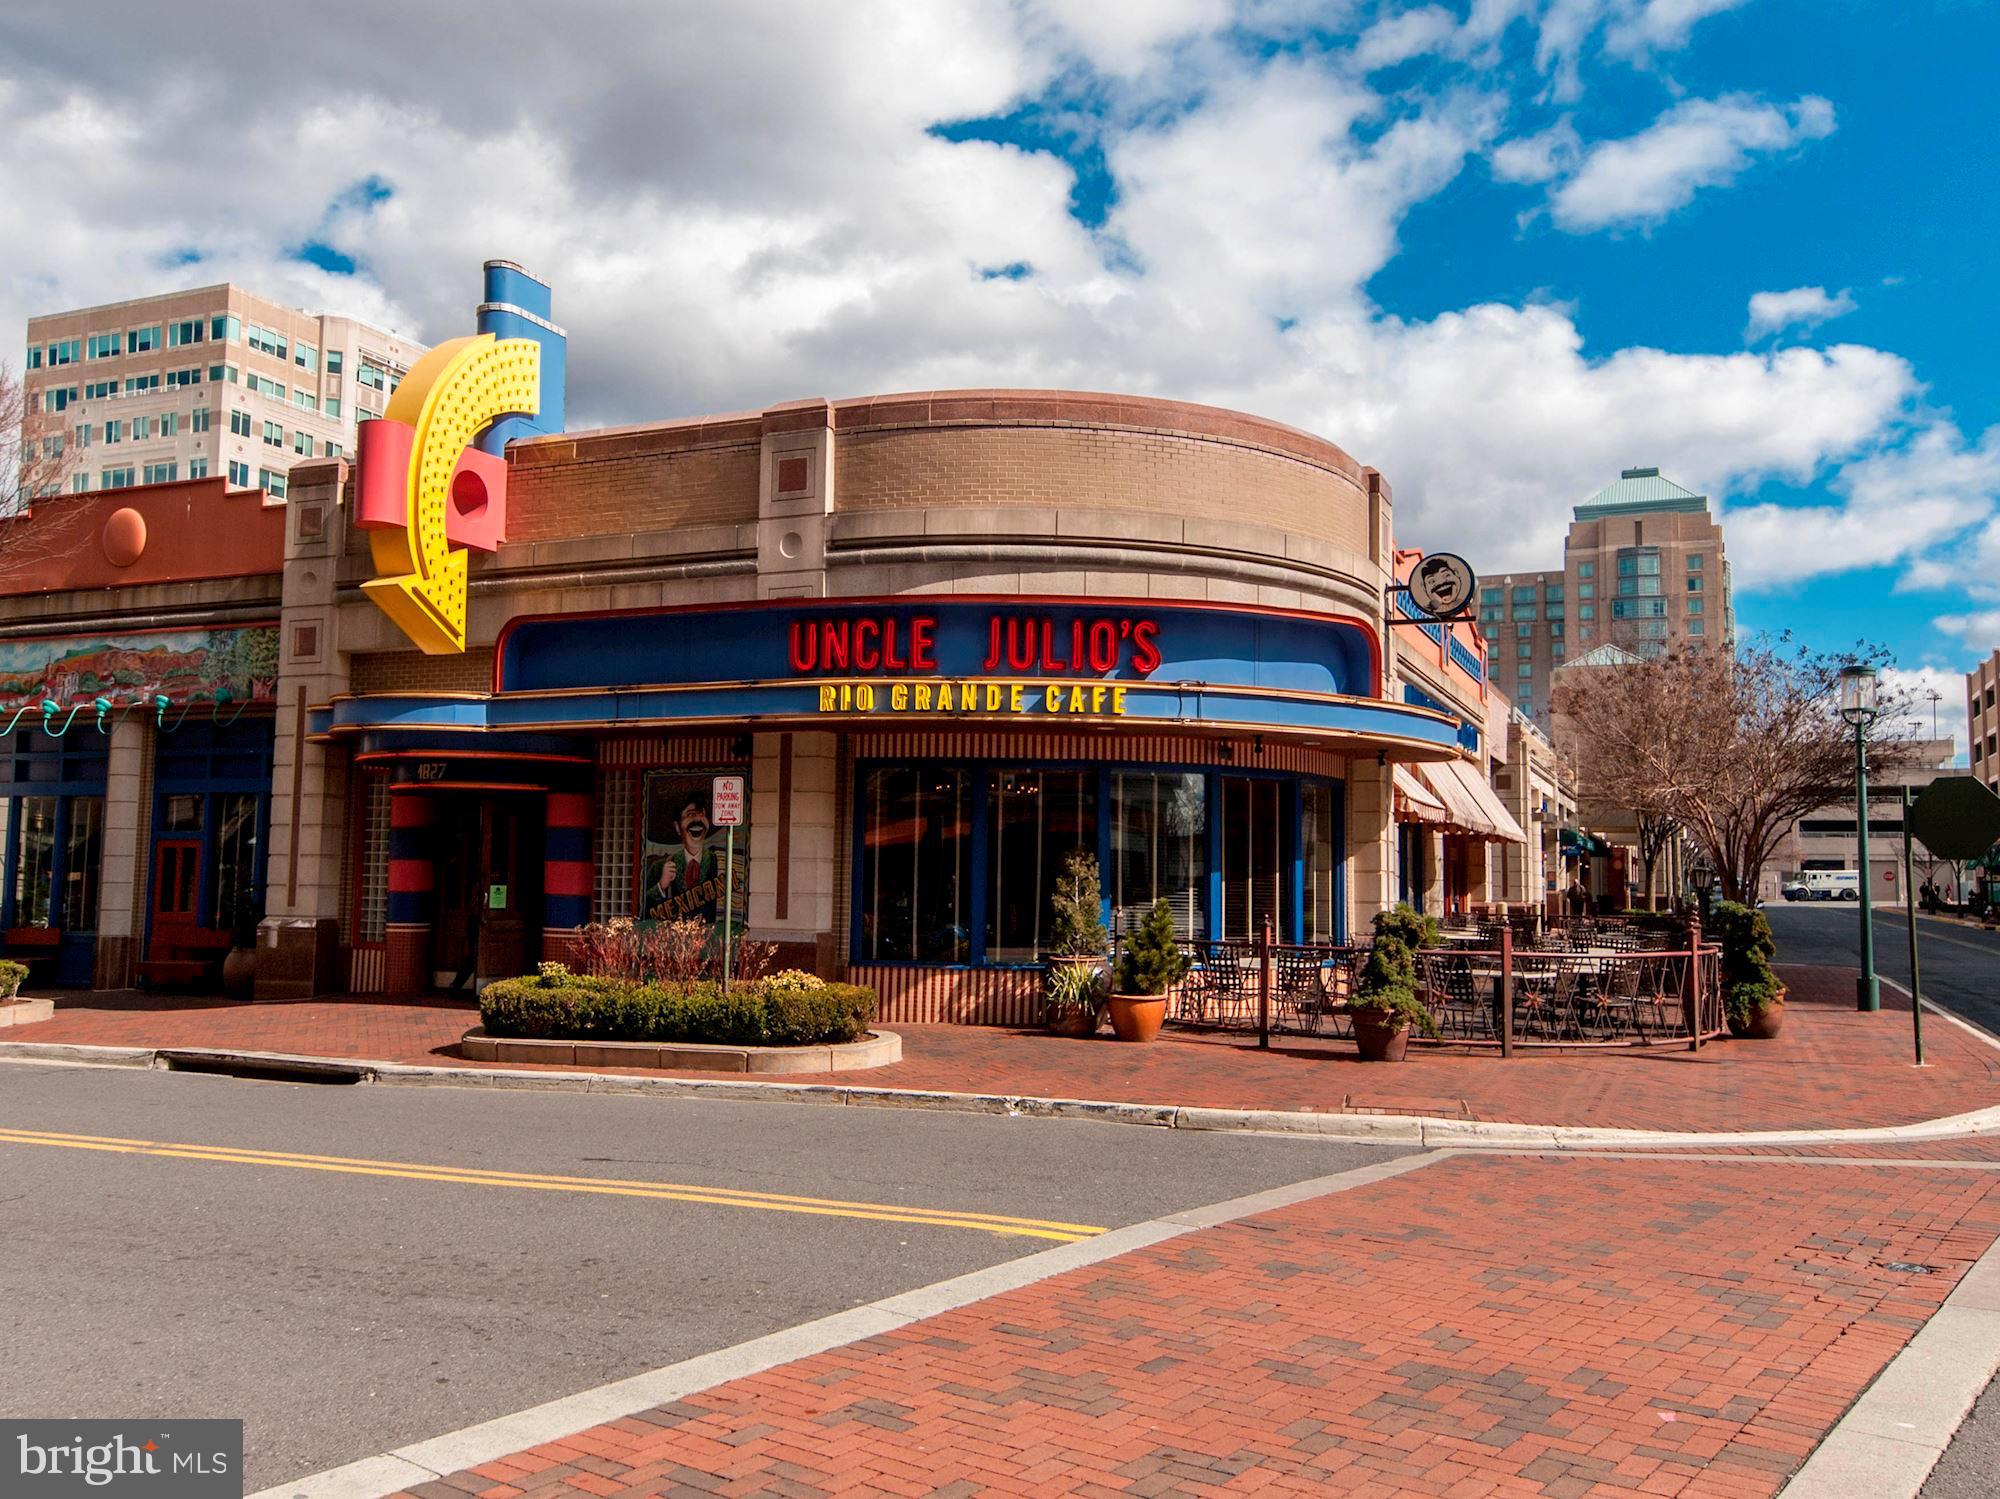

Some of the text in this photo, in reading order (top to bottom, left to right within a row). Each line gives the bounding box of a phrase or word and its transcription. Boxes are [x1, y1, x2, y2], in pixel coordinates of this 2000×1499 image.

[789, 615, 1162, 674] UNCLE JULIO'S
[819, 683, 1127, 714] RIO GRANDE CAFE
[417, 762, 447, 779] 1827
[722, 782, 734, 791] NO
[716, 792, 740, 801] PARKING
